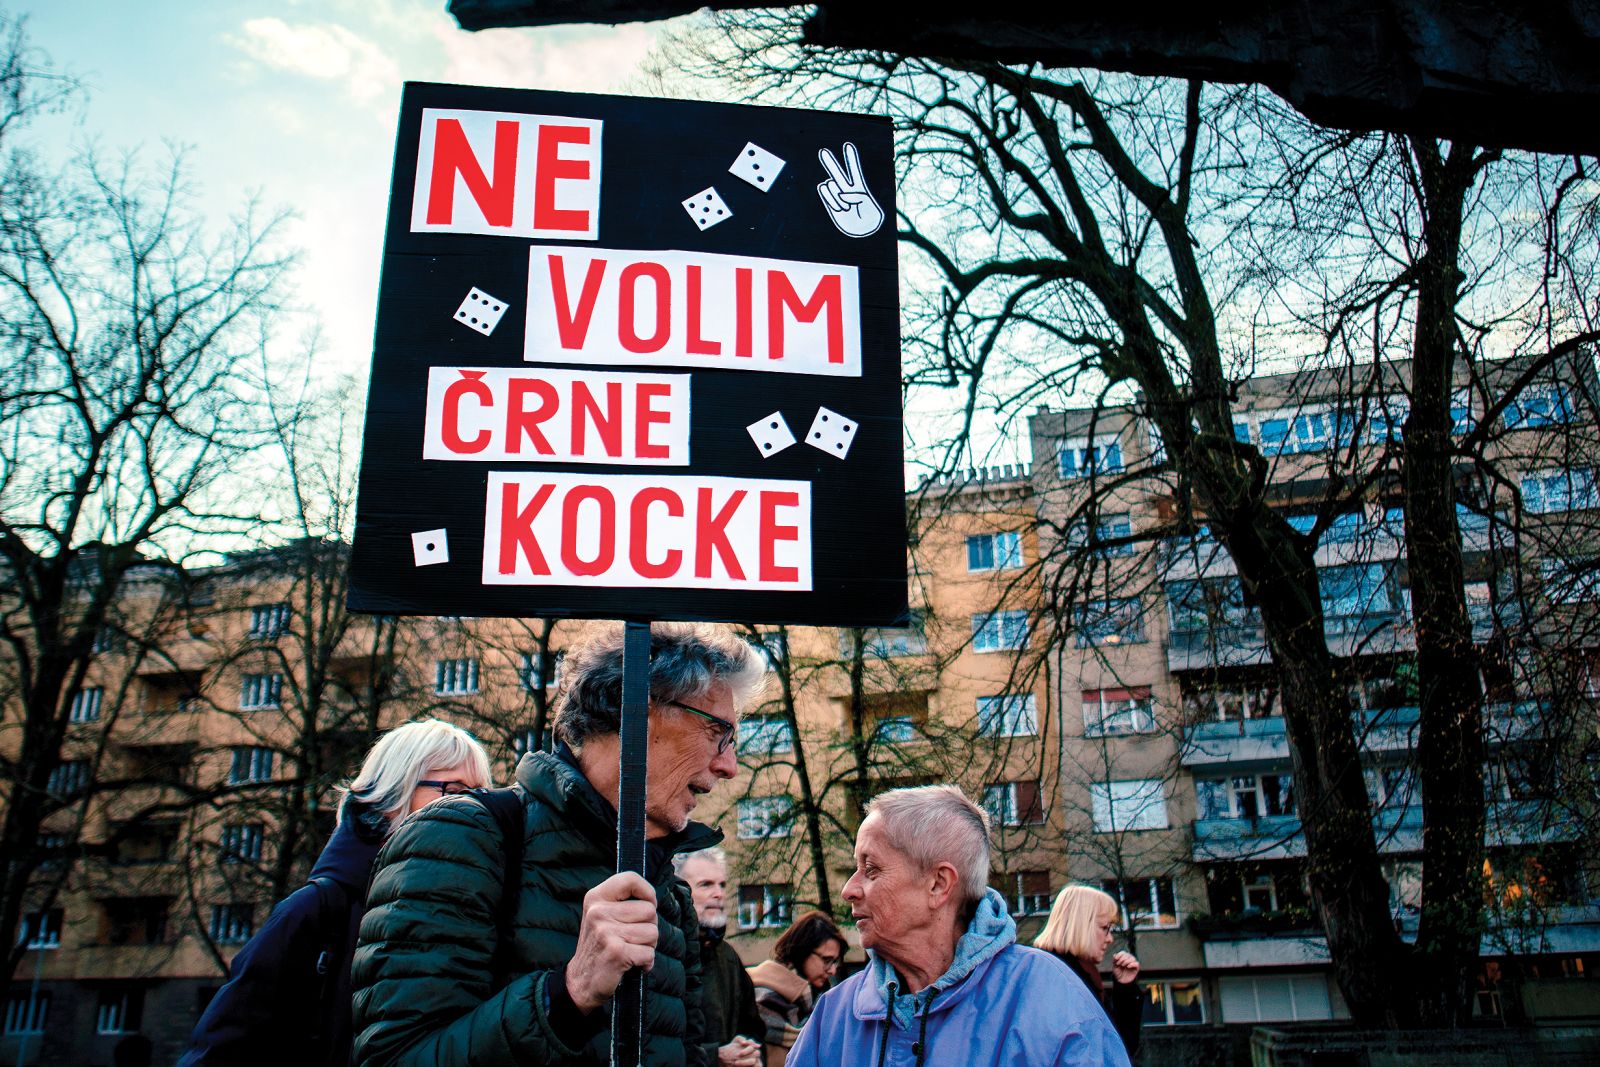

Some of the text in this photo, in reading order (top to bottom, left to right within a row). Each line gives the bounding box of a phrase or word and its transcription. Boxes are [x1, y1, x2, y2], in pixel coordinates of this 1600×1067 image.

[426, 118, 591, 231] NE
[548, 254, 844, 364] VOLIM
[441, 369, 671, 459] ČRNE
[498, 482, 799, 582] KOCKE
